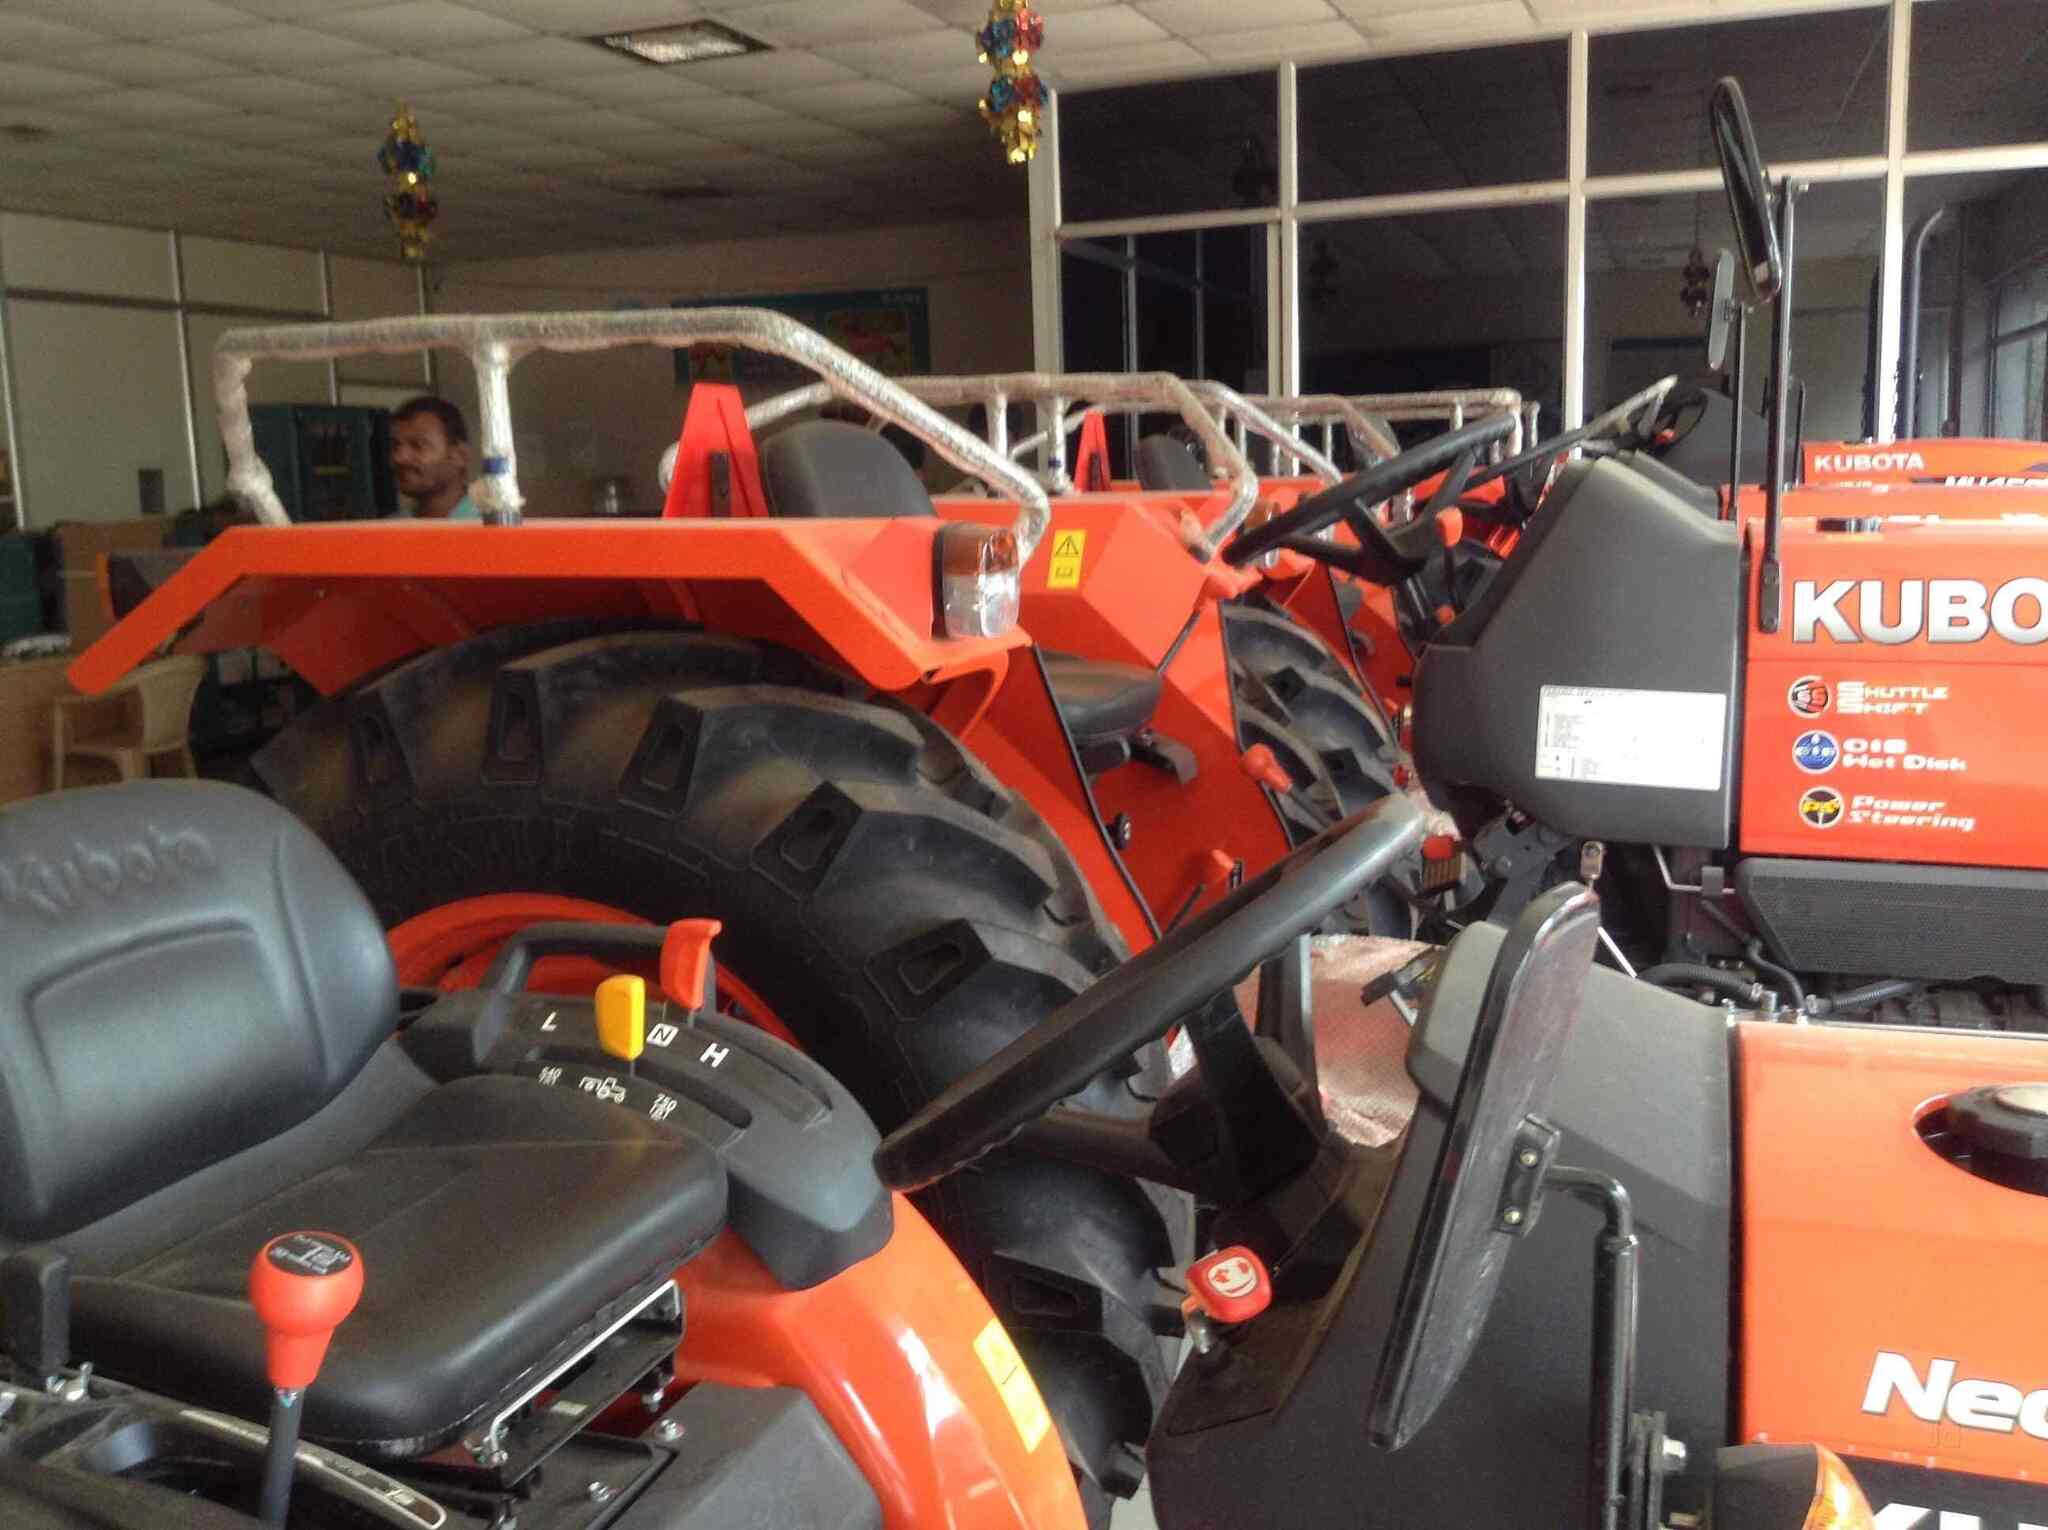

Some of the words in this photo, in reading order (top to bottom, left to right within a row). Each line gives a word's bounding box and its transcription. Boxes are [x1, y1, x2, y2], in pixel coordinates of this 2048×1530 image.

[1814, 453, 1925, 472] KUBOTA
[1793, 577, 2048, 645] KUBO
[540, 1011, 557, 1032] L
[700, 1042, 730, 1068] H
